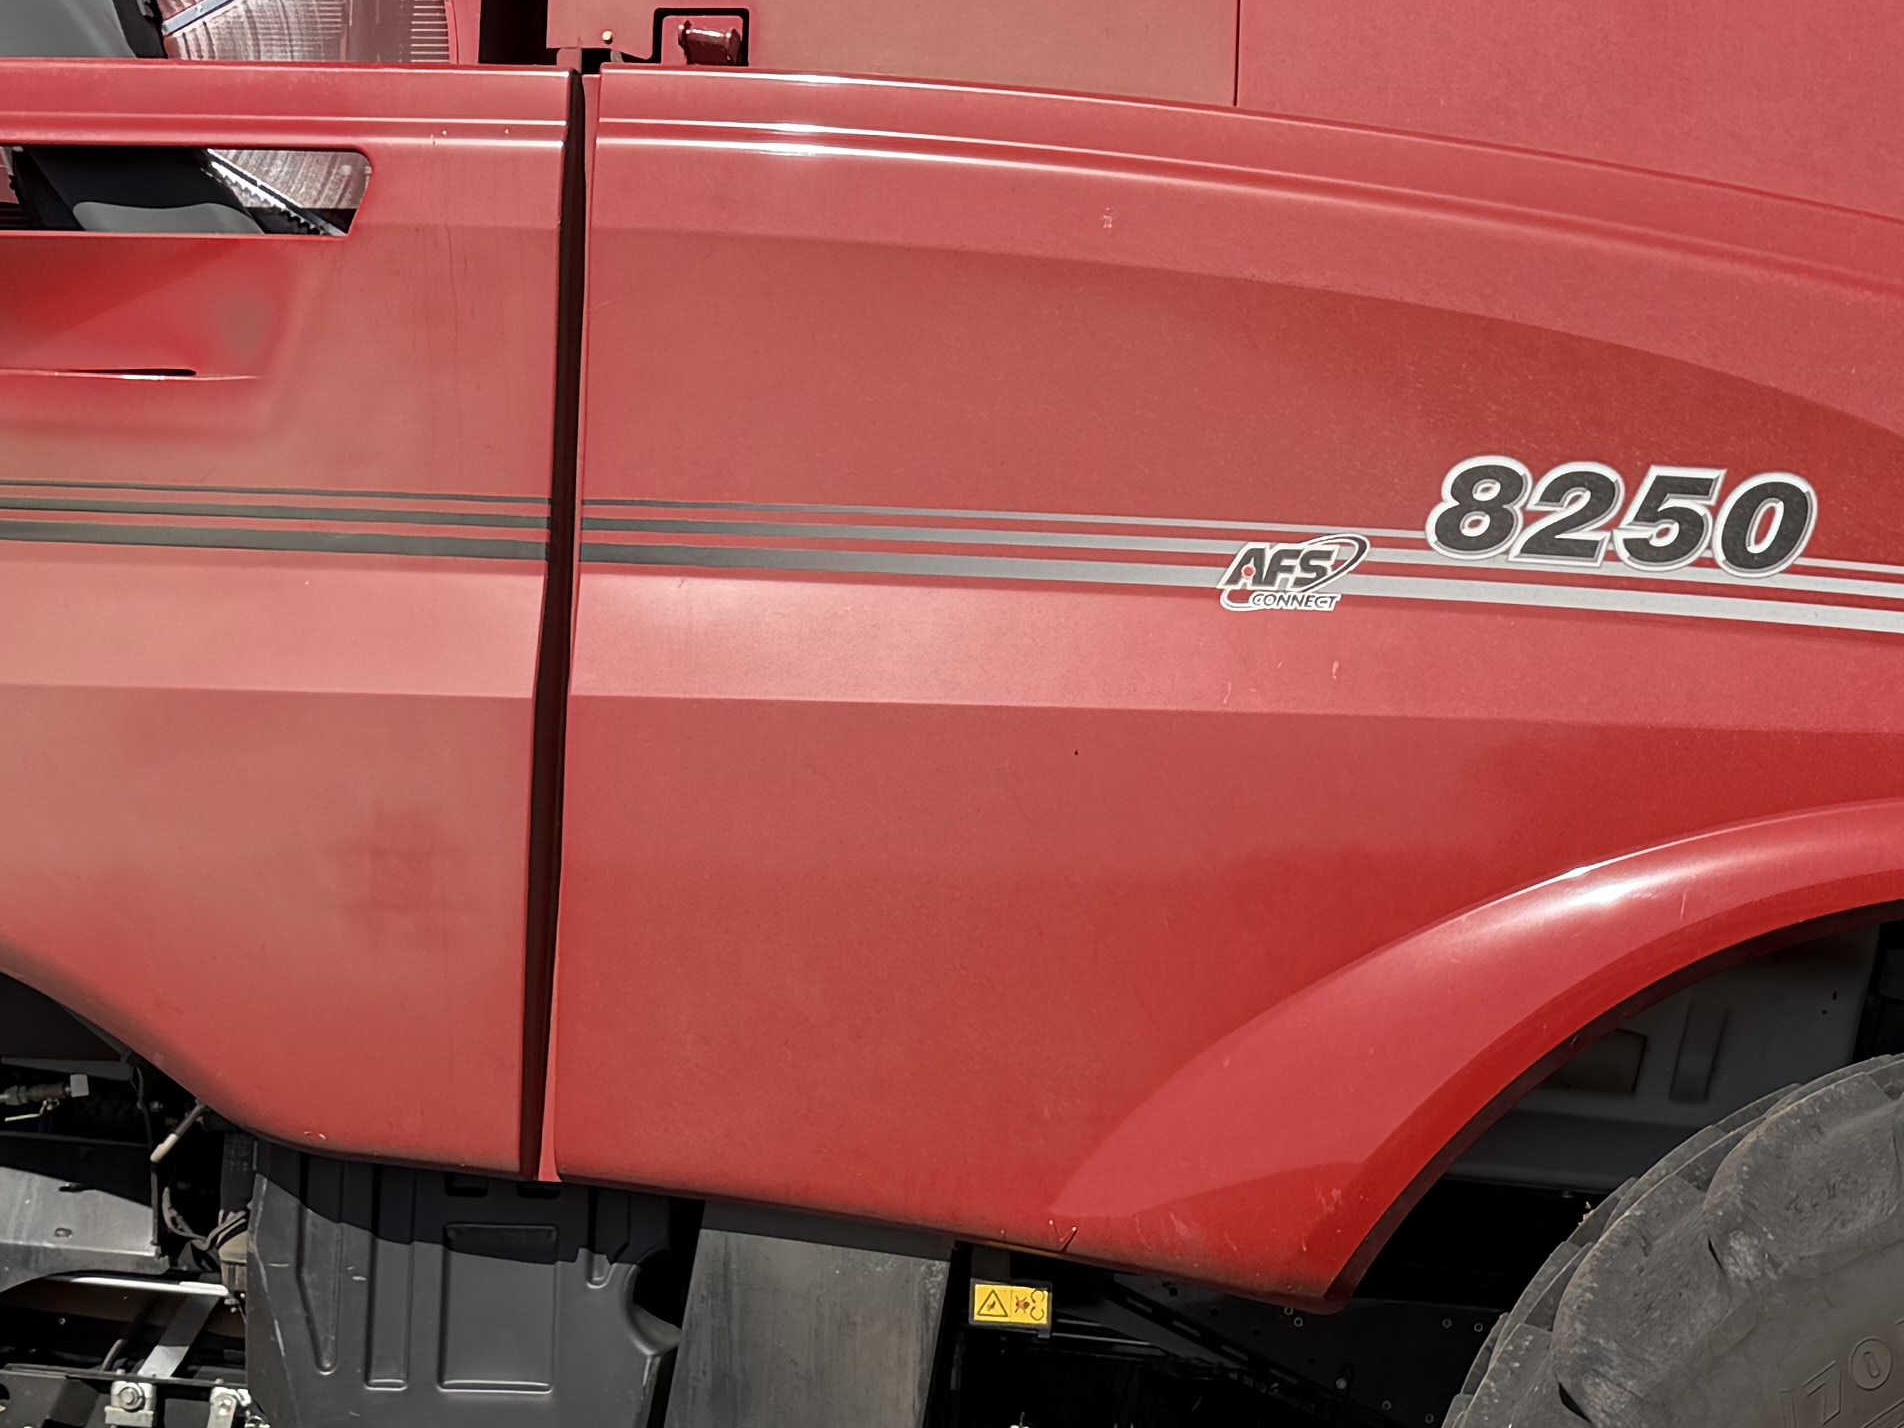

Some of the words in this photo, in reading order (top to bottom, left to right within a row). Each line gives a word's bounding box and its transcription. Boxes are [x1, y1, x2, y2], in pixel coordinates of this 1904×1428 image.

[1424, 454, 1816, 577] 8250
[1218, 542, 1340, 590] AFS
[1250, 592, 1341, 611] CONNECT
